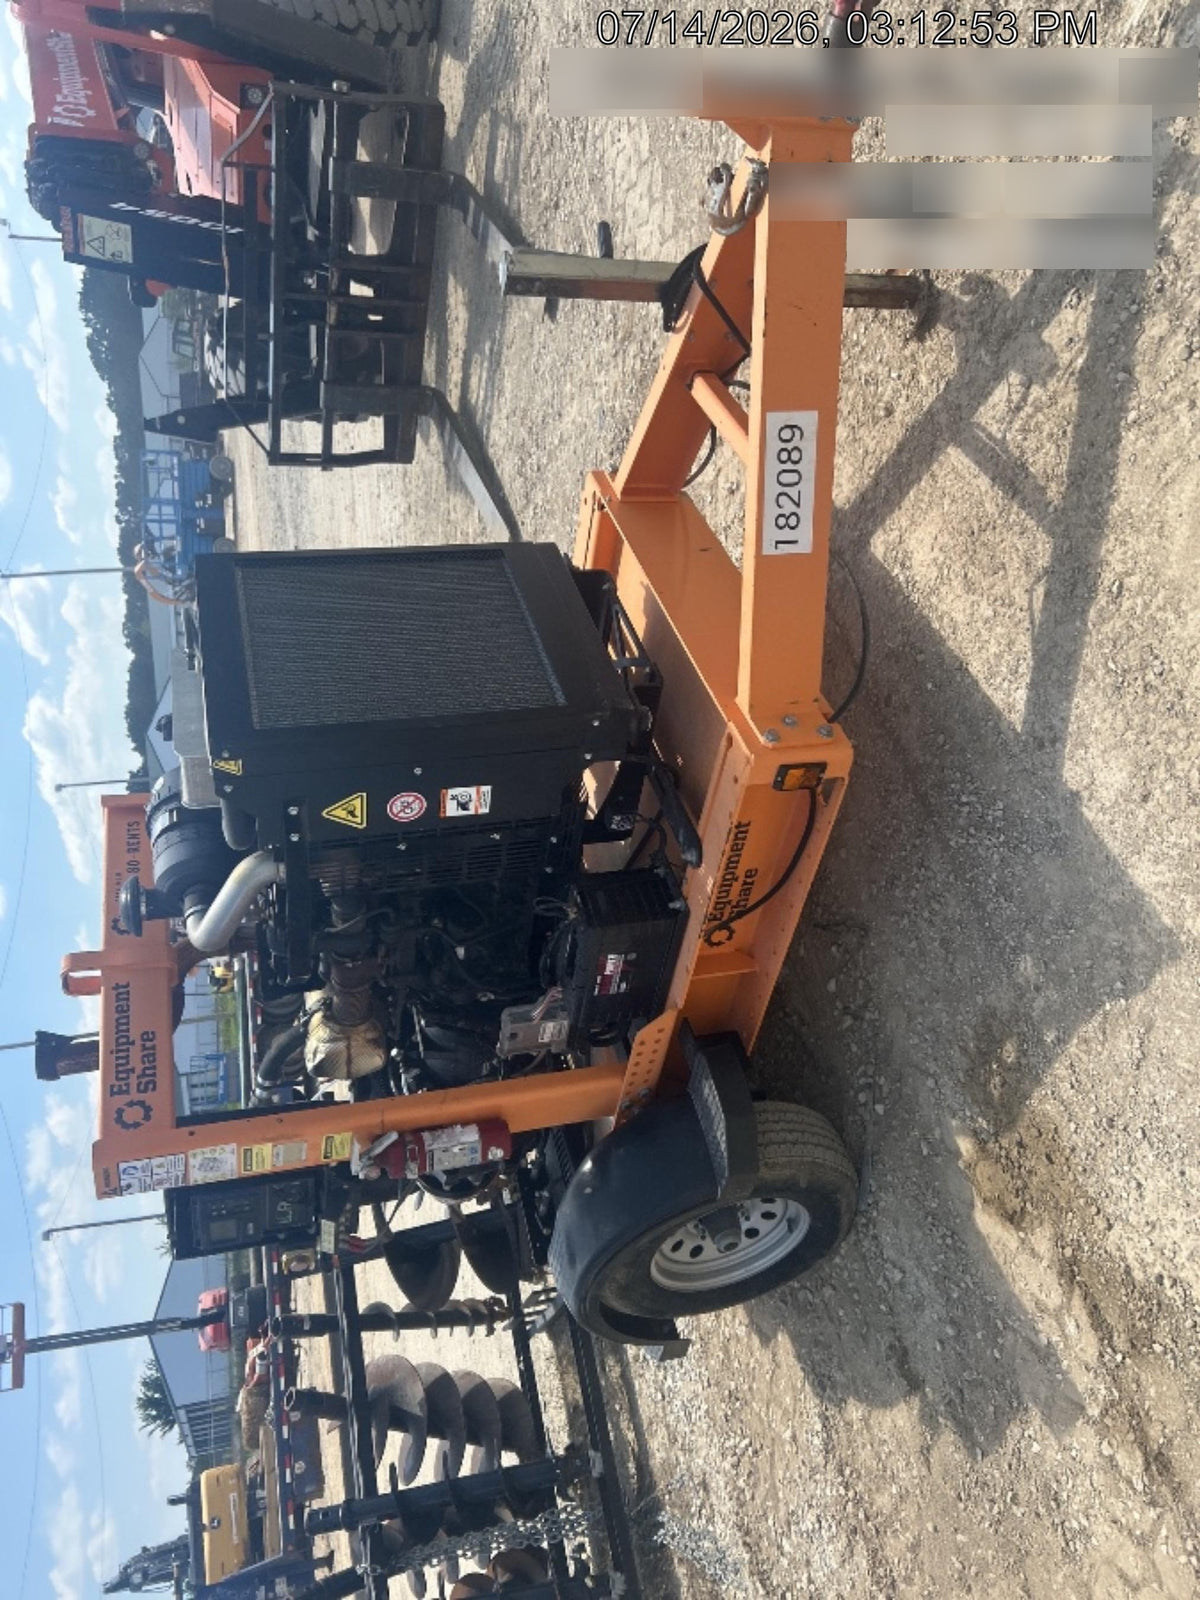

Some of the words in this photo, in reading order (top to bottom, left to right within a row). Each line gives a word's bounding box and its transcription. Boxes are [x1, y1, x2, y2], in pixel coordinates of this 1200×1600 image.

[774, 424, 804, 550] 182089
[707, 820, 751, 923] Equipment
[728, 868, 758, 921] hare
[109, 982, 135, 1097] Equipment
[136, 1030, 158, 1094] Share
